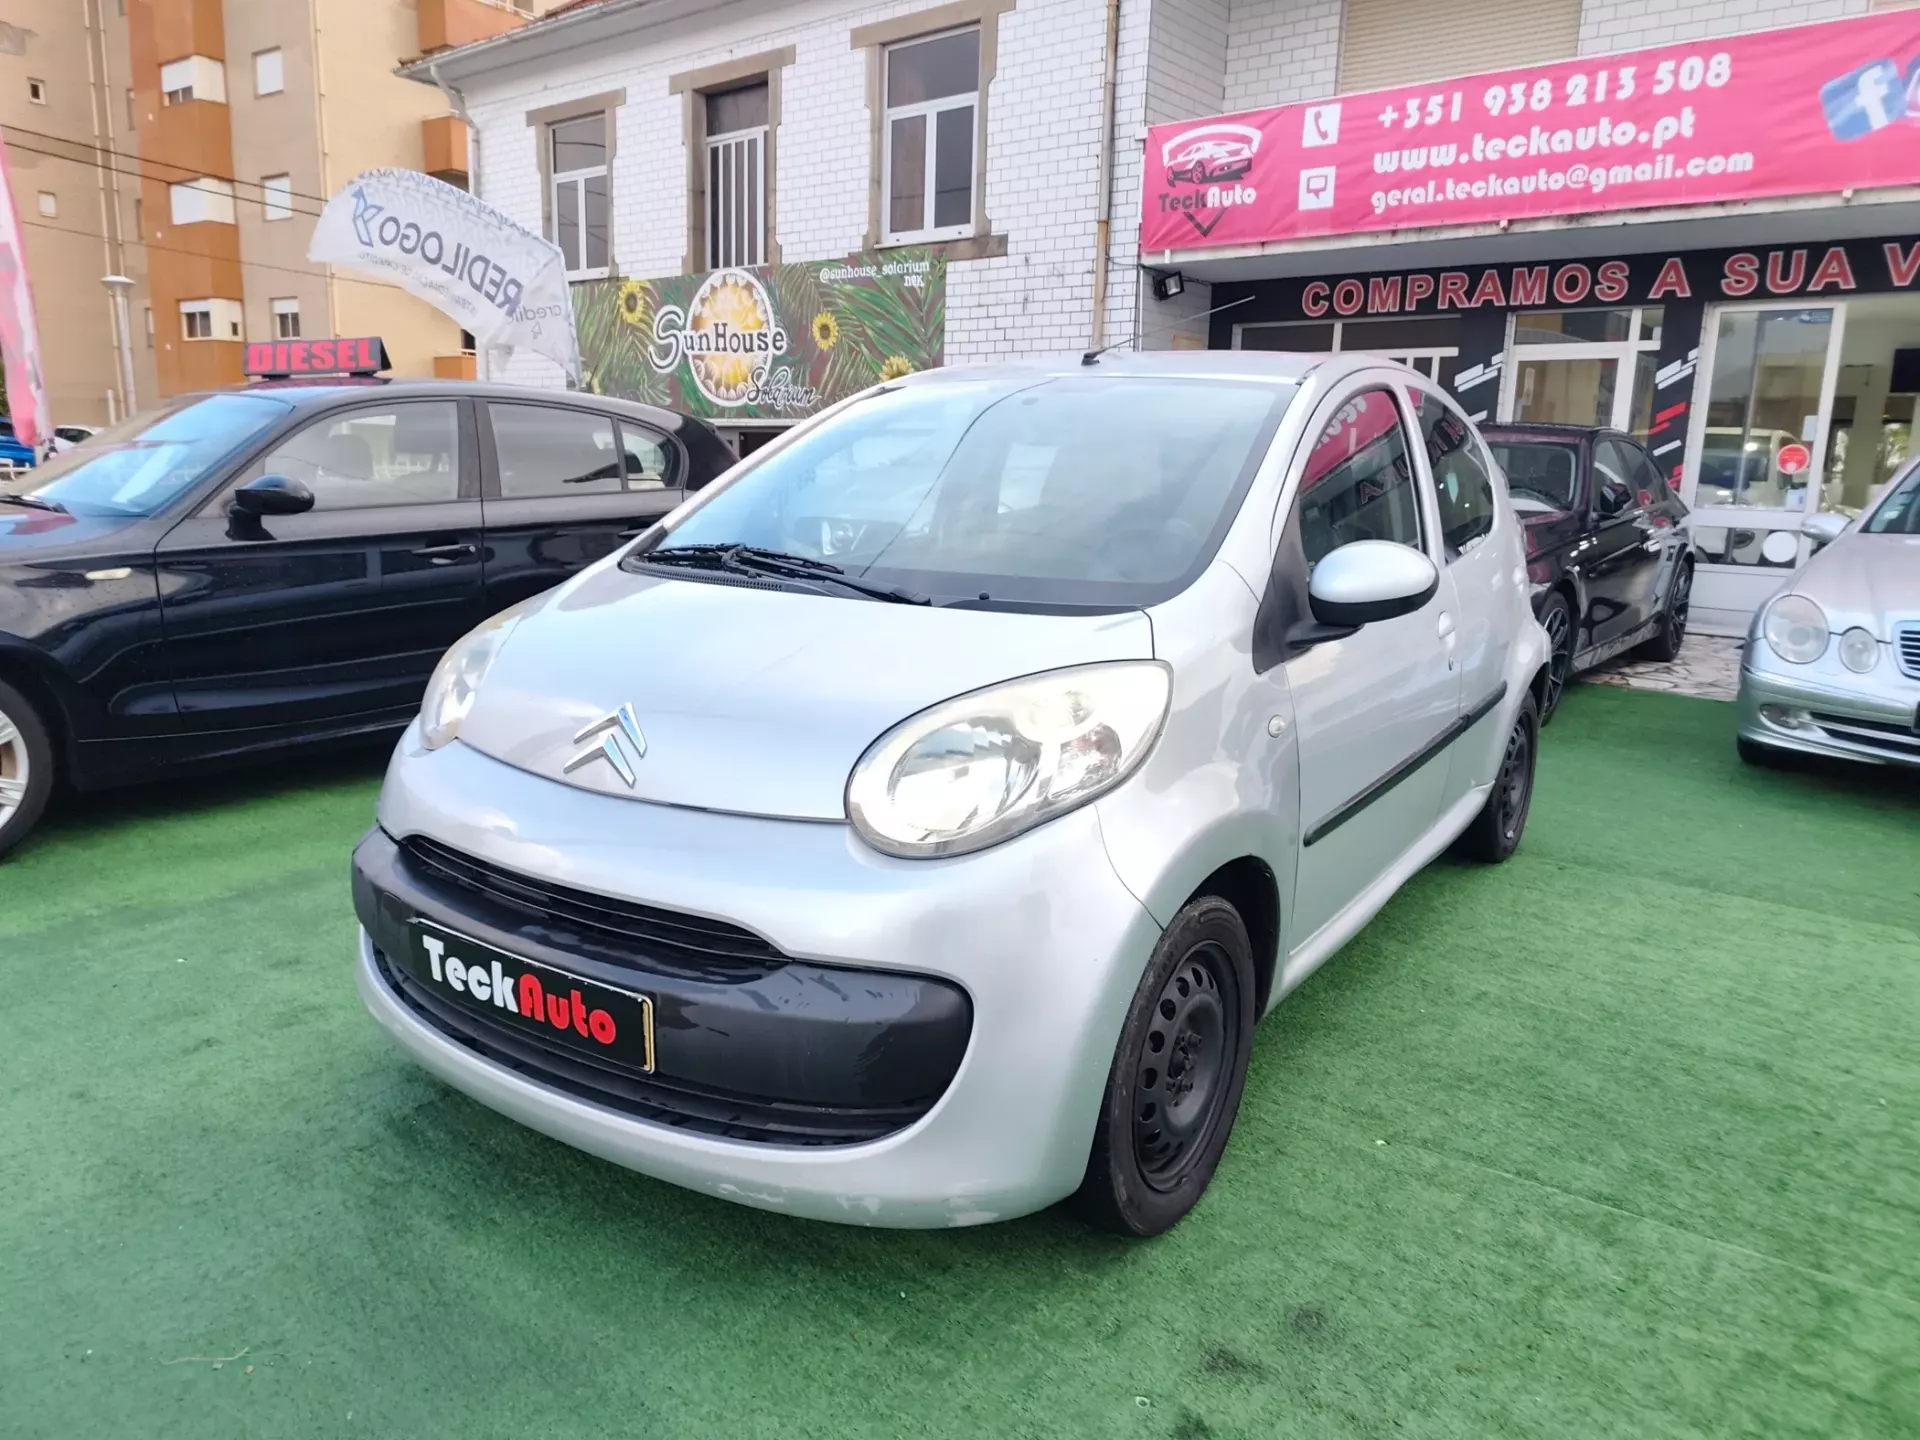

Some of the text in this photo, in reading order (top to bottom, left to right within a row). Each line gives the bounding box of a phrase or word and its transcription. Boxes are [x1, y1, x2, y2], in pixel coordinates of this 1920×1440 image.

[1378, 53, 1731, 129] +351 938 213 508
[1373, 106, 1695, 174] www.teckauto.pt
[1159, 184, 1257, 213] TeckAuto
[1371, 152, 1754, 214] geral.teckauto@gmail.com
[1302, 261, 1629, 317] COMPRAMOS
[1648, 258, 1692, 299] A
[1721, 247, 1856, 296] SUA
[247, 338, 377, 372] DIESEL
[649, 305, 786, 373] SunHouse
[746, 365, 819, 410] Solarium
[422, 934, 616, 1045] TeckAuto
